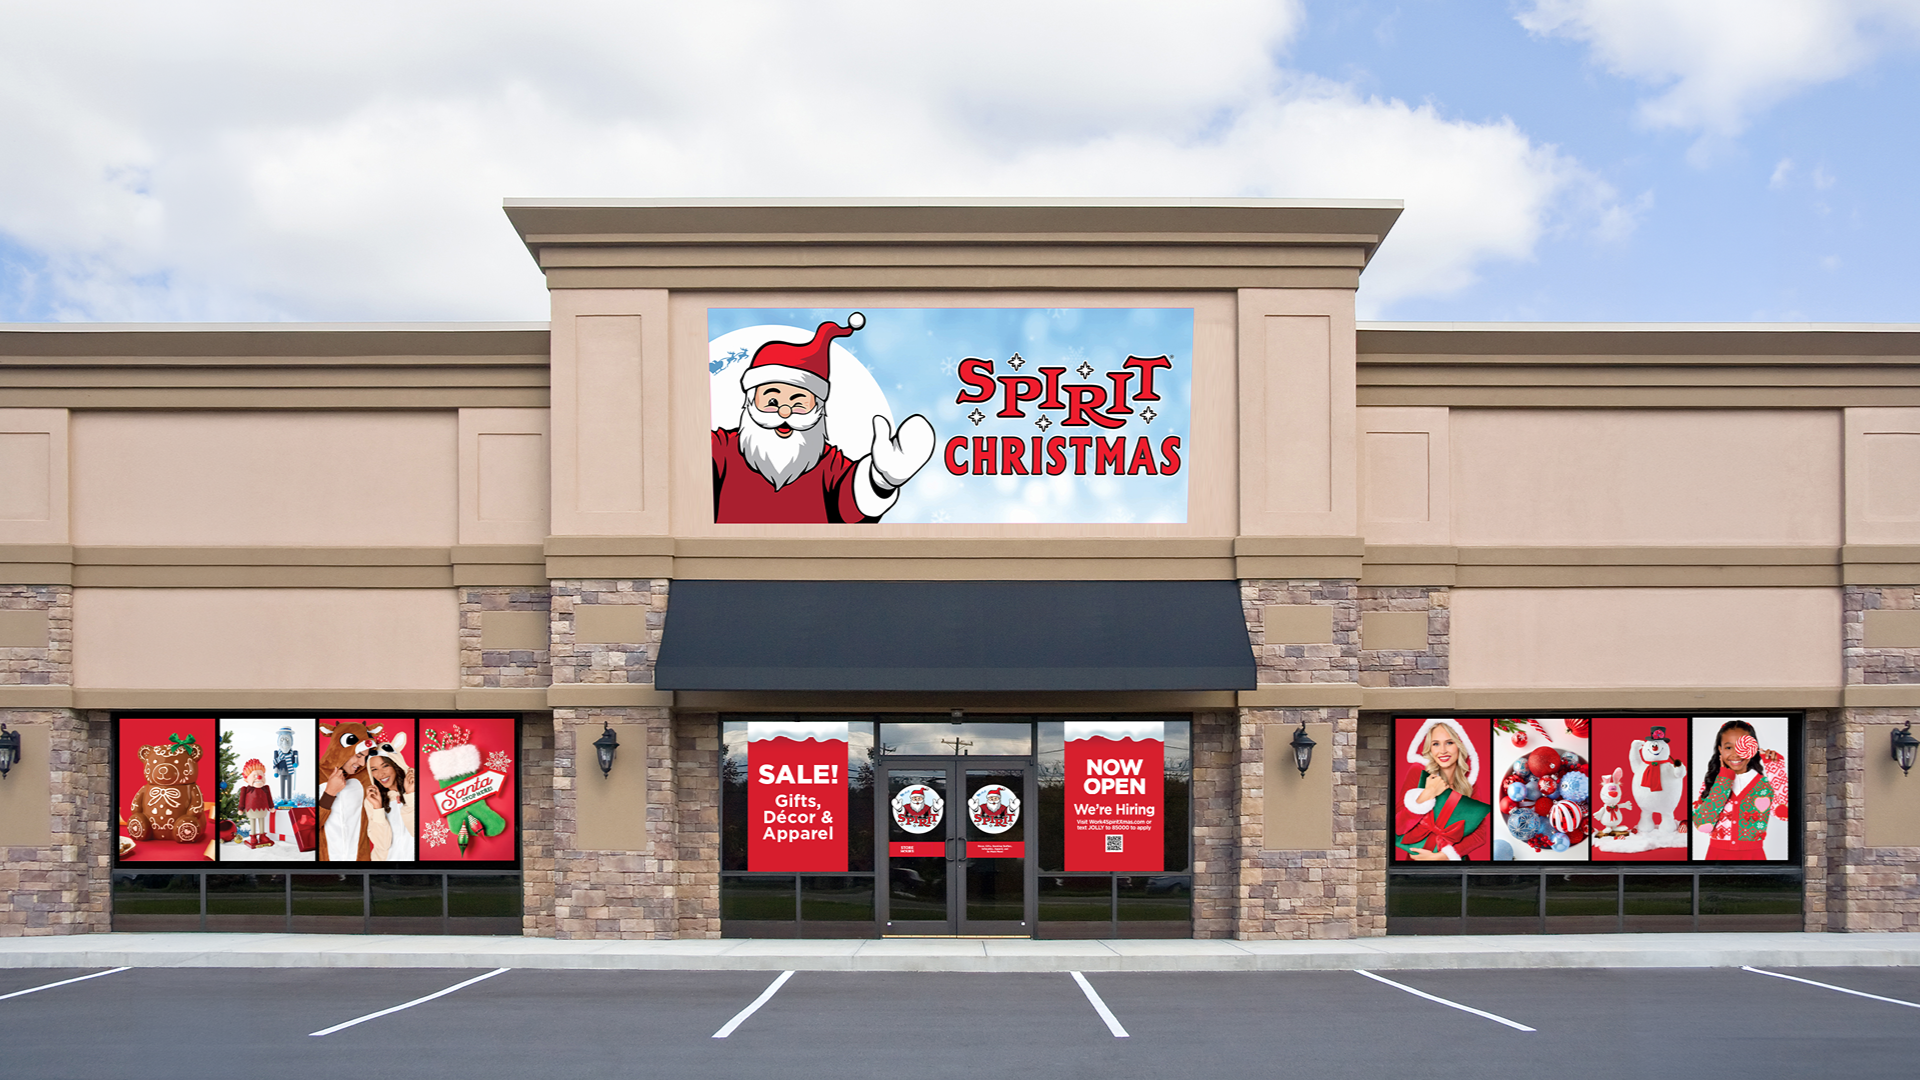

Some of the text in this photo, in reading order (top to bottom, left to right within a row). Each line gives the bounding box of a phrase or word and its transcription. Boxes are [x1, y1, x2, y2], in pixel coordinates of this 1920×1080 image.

[955, 355, 1172, 429] SPIRIT
[944, 435, 1181, 476] CHRISTMAS
[758, 764, 839, 784] SALE!
[1087, 759, 1143, 775] NOW
[441, 777, 493, 811] Santa
[1083, 778, 1146, 795] OPEN
[462, 792, 476, 802] STOP
[775, 794, 821, 810] Gifts,
[763, 810, 833, 824] Décor &
[1074, 803, 1155, 817] We're Hiring
[898, 813, 939, 827] SPIRIT
[974, 813, 1015, 827] SPIRIT
[763, 826, 833, 842] Apparel
